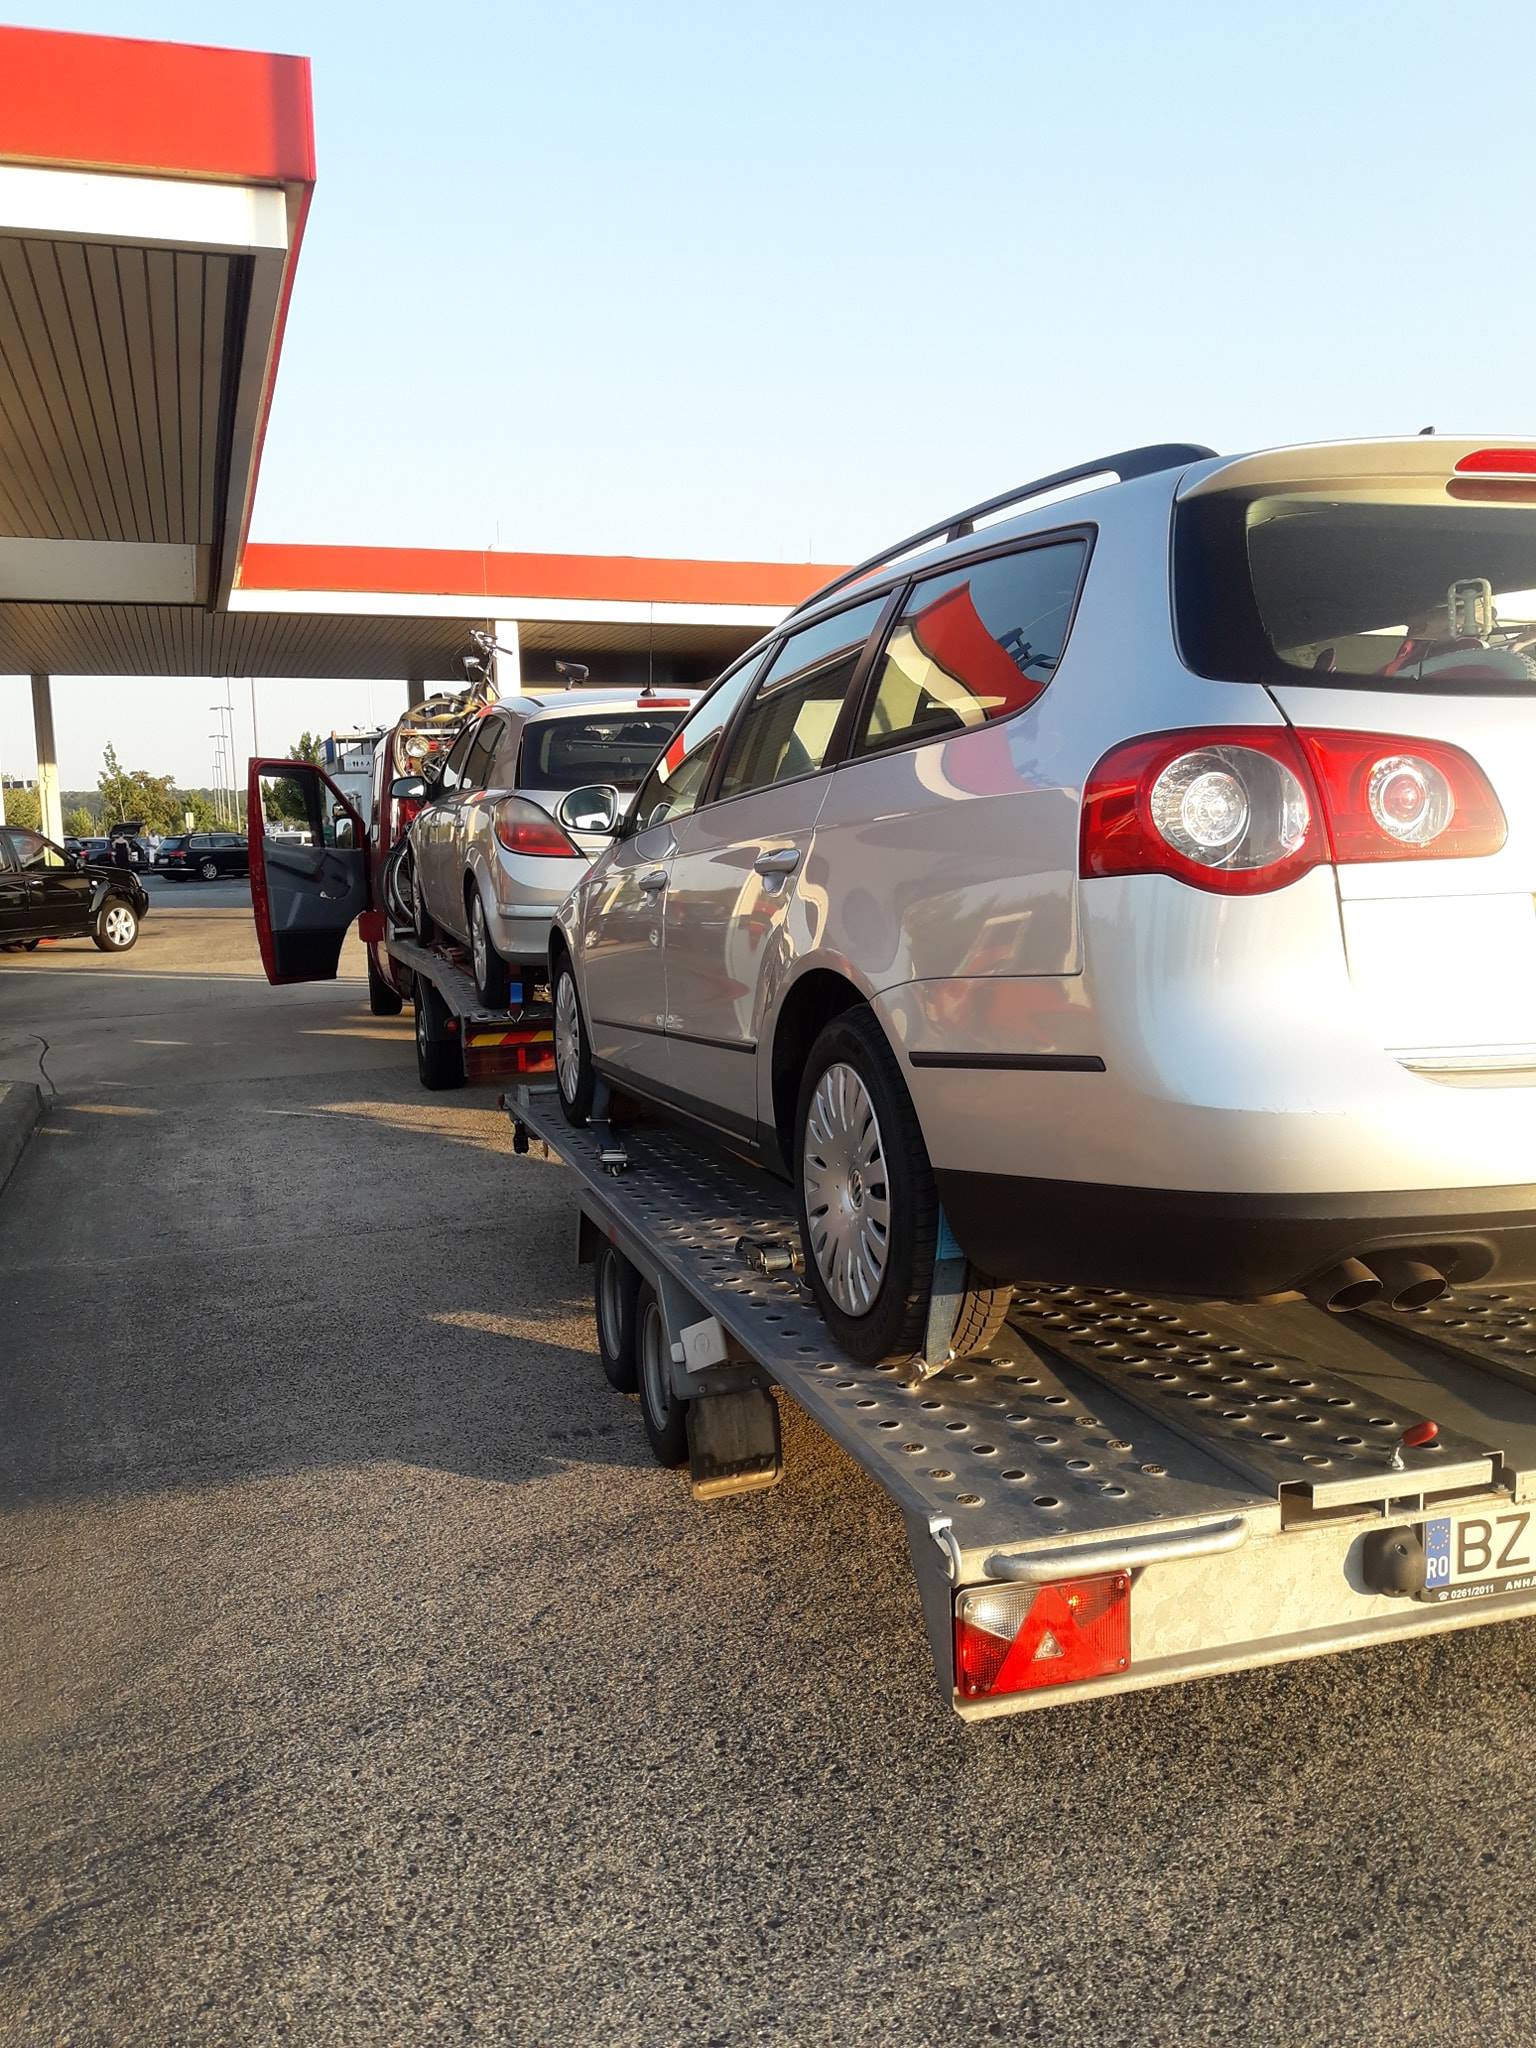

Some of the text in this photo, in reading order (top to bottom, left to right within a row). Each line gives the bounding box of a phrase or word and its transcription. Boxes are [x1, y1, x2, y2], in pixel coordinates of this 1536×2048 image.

[1457, 1512, 1530, 1574] BZ
[1427, 1556, 1448, 1579] RO
[1451, 1584, 1494, 1599] 0261/2011
